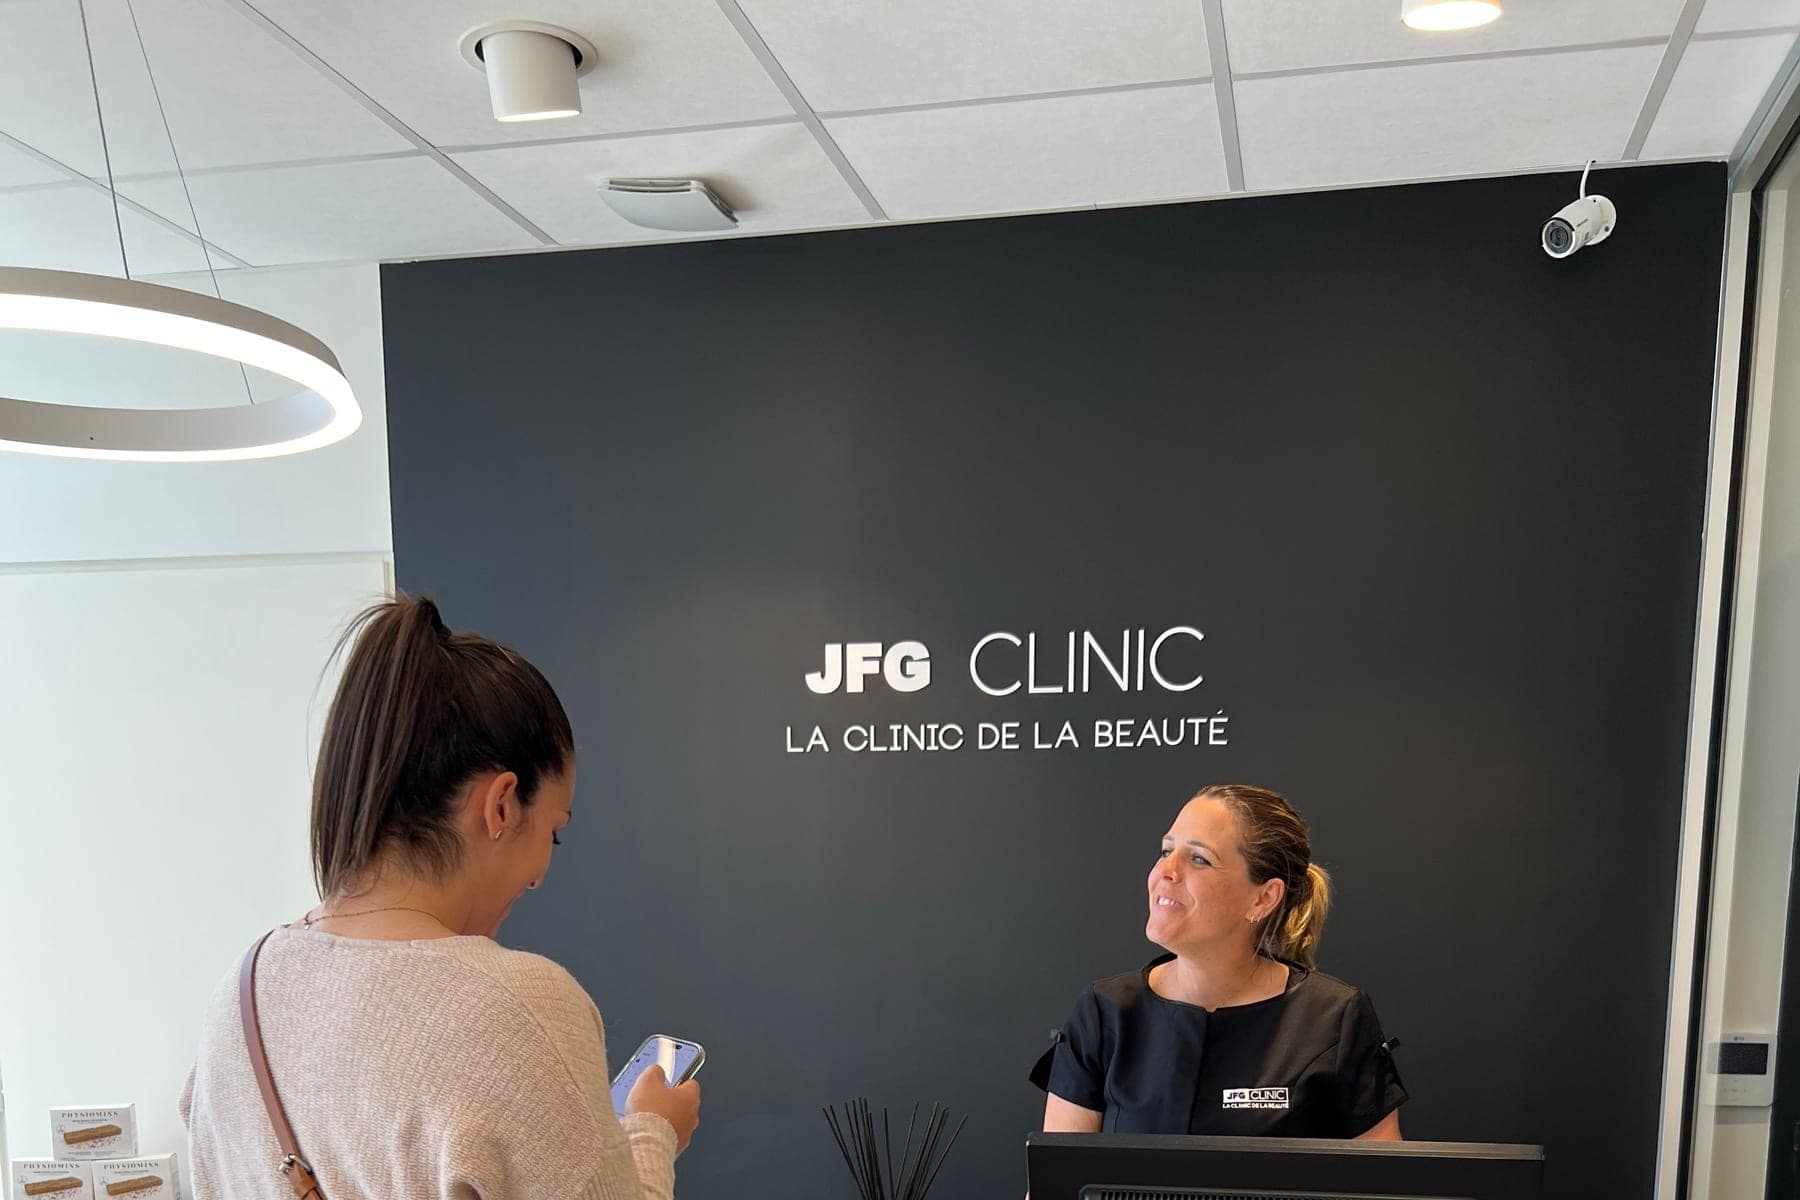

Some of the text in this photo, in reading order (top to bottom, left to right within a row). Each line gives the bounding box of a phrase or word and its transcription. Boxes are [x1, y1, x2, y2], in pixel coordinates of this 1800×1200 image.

[804, 626, 1205, 697] JFG CLINIC
[786, 709, 1229, 753] LA CLINIC DE LA BEAUTÉ
[1227, 1090, 1285, 1100] JFG CLINIC
